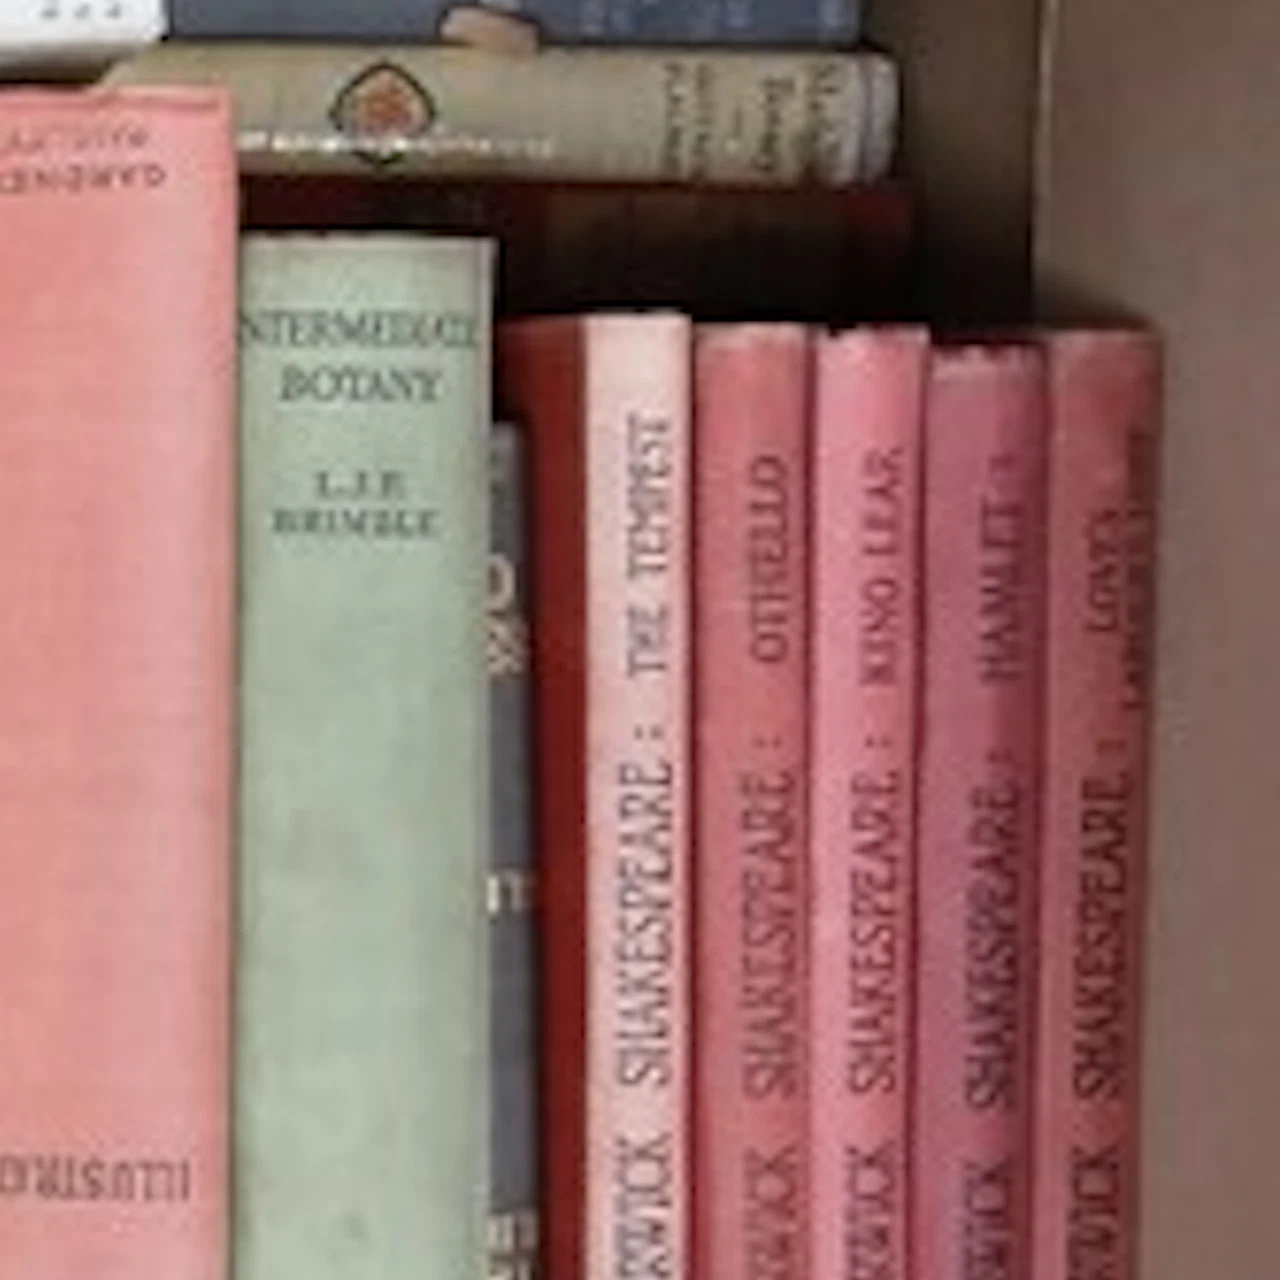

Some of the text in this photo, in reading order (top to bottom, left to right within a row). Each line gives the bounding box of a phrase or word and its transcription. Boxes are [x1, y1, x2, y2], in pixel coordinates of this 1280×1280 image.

[279, 366, 443, 403] BOTANY
[626, 413, 675, 582] TEMPEST
[861, 444, 906, 558] LEAR
[748, 453, 790, 666] OTHELLO
[977, 495, 1028, 688] HAMLET
[626, 602, 670, 679] THE
[856, 577, 900, 689] KING
